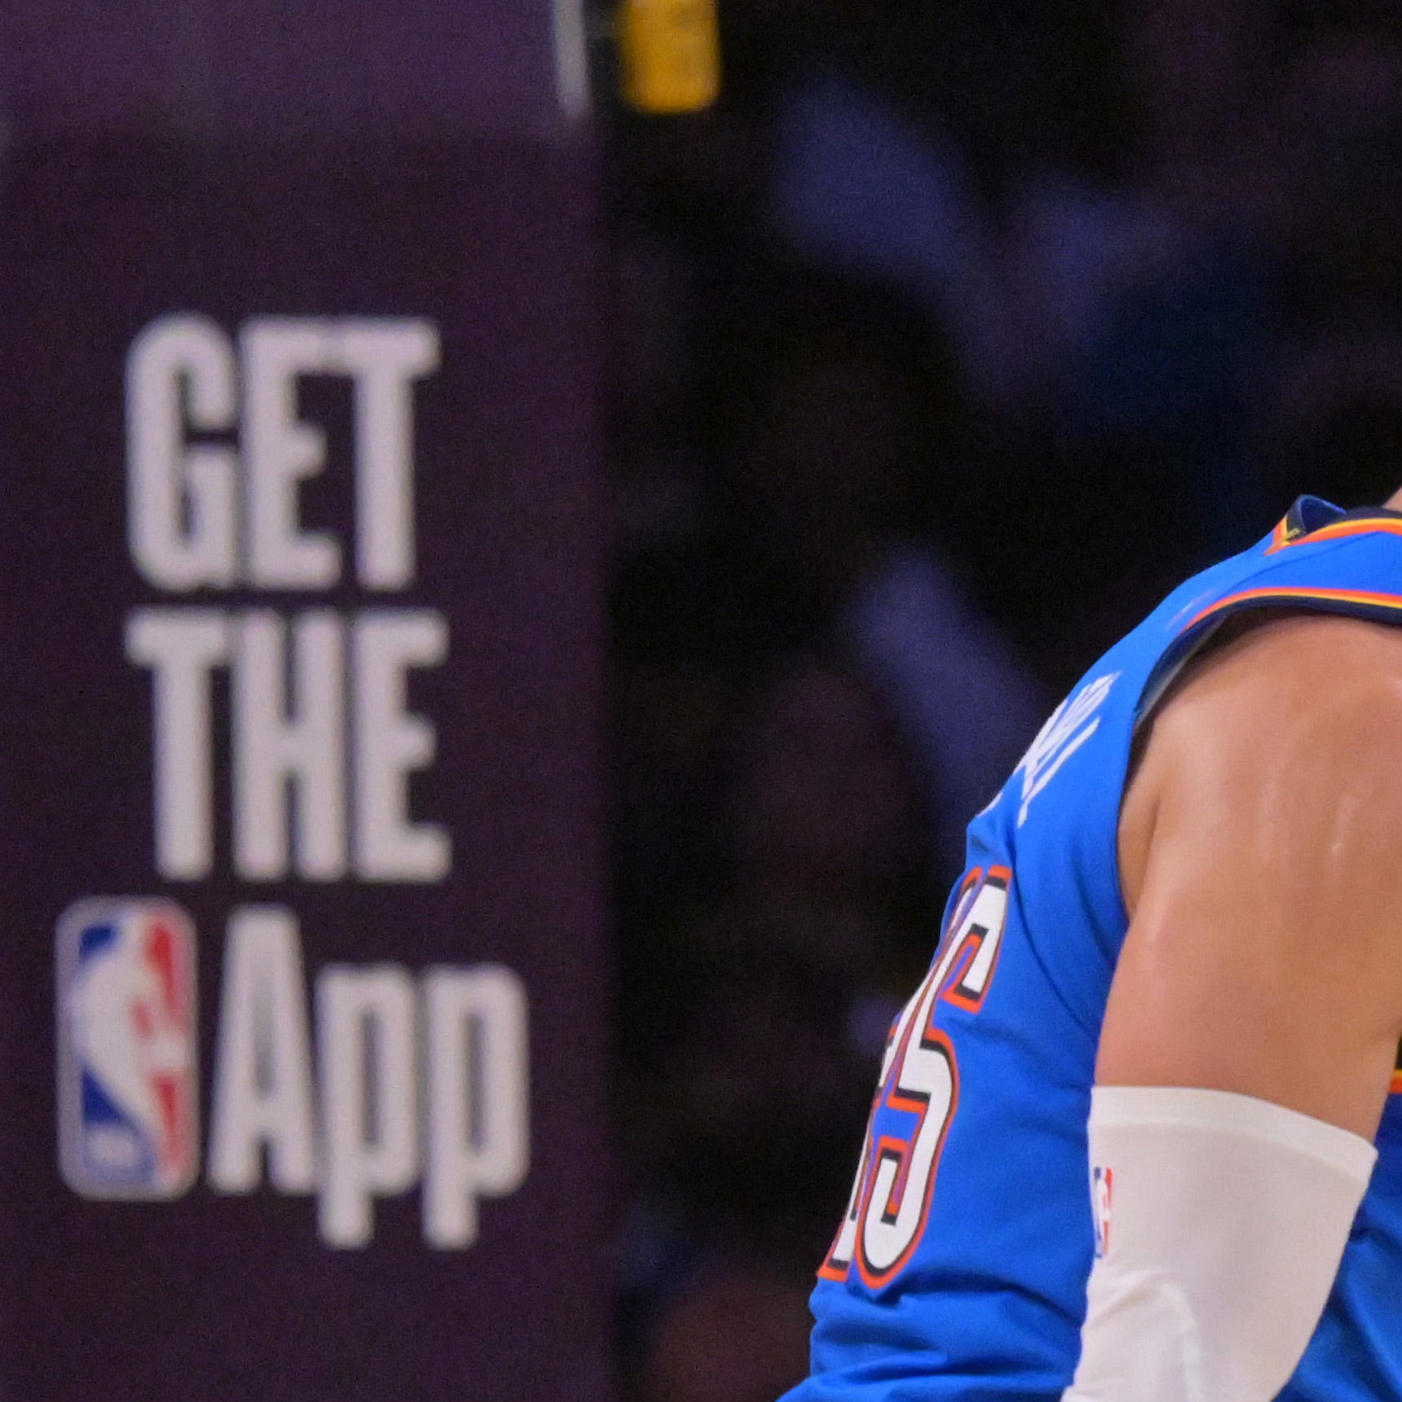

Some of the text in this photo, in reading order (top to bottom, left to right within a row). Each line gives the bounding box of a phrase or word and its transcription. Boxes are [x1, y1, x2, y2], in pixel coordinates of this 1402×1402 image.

[124, 310, 442, 591] GET
[123, 609, 452, 883] THE
[206, 904, 532, 1250] App
